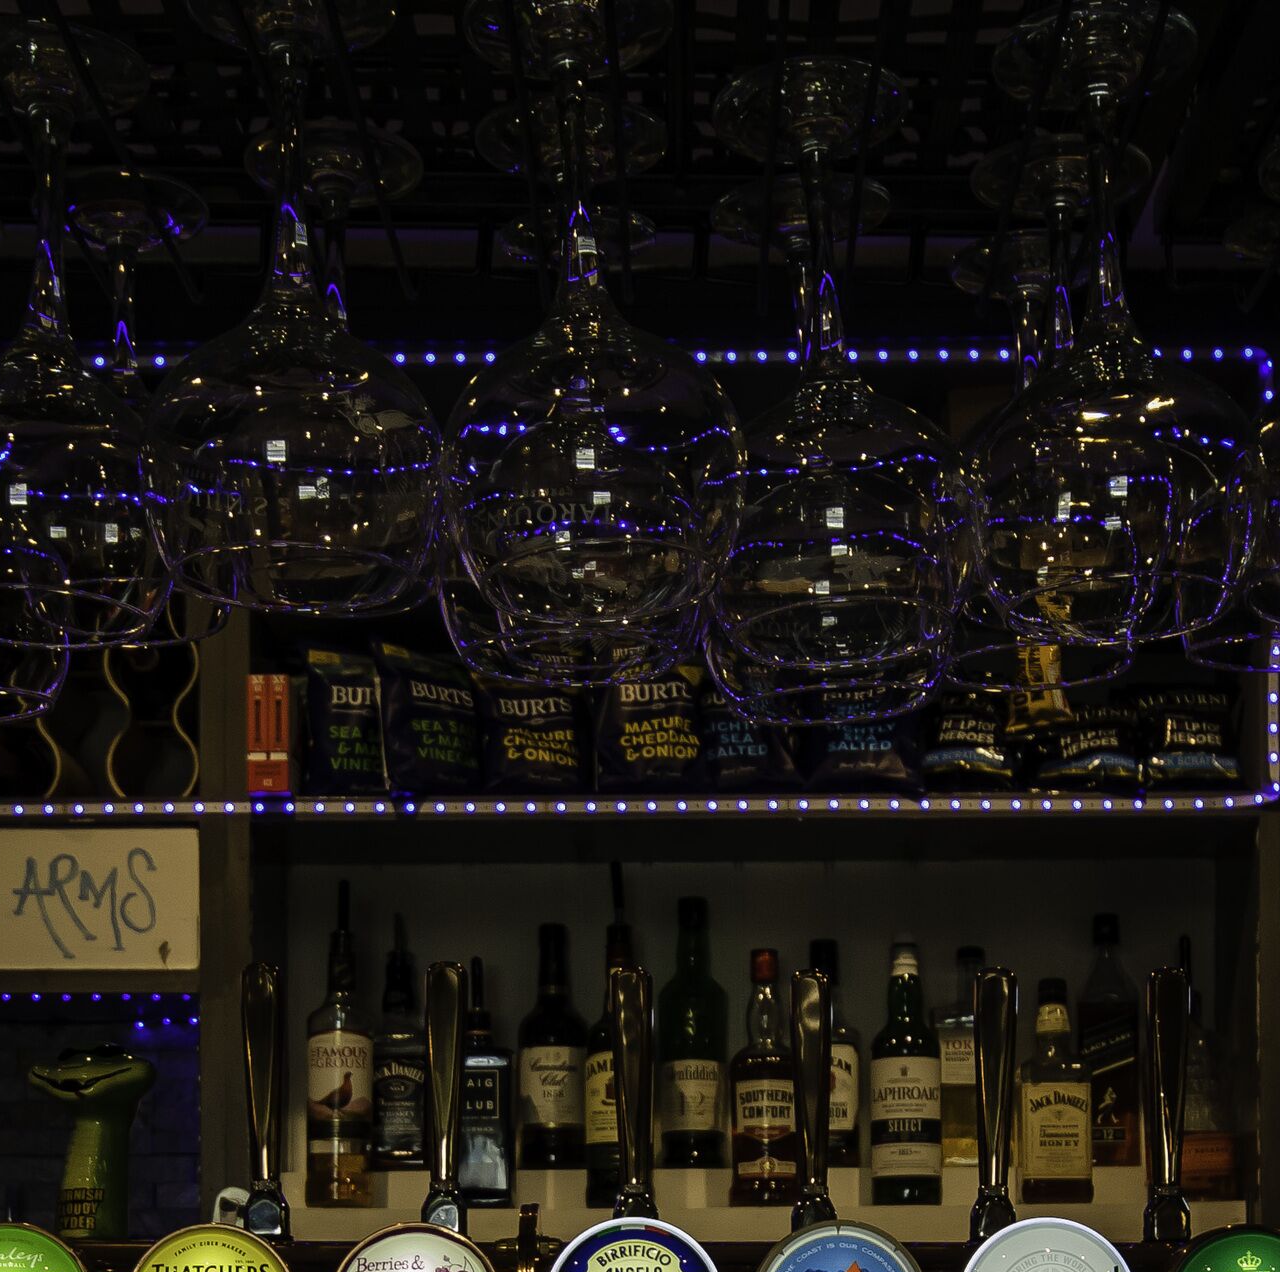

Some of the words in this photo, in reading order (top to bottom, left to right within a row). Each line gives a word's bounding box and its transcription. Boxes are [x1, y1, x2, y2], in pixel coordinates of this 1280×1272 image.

[499, 696, 572, 716] BURTS
[624, 715, 694, 734] MATURE
[317, 1046, 368, 1058] FAMOUS
[1030, 1094, 1051, 1113] JACK
[742, 1105, 791, 1119] COMFORT
[887, 1118, 923, 1133] SELECT
[1039, 1139, 1080, 1147] HONEY
[174, 1243, 197, 1257] FAMILY
[221, 1242, 247, 1257] MAKERS
[596, 1244, 672, 1267] BIRRIFICIO
[796, 1245, 823, 1263] COAST
[838, 1242, 858, 1250] OUR
[356, 1257, 409, 1272] Berries
[411, 1254, 425, 1270] &
[1040, 1253, 1059, 1263] THE
